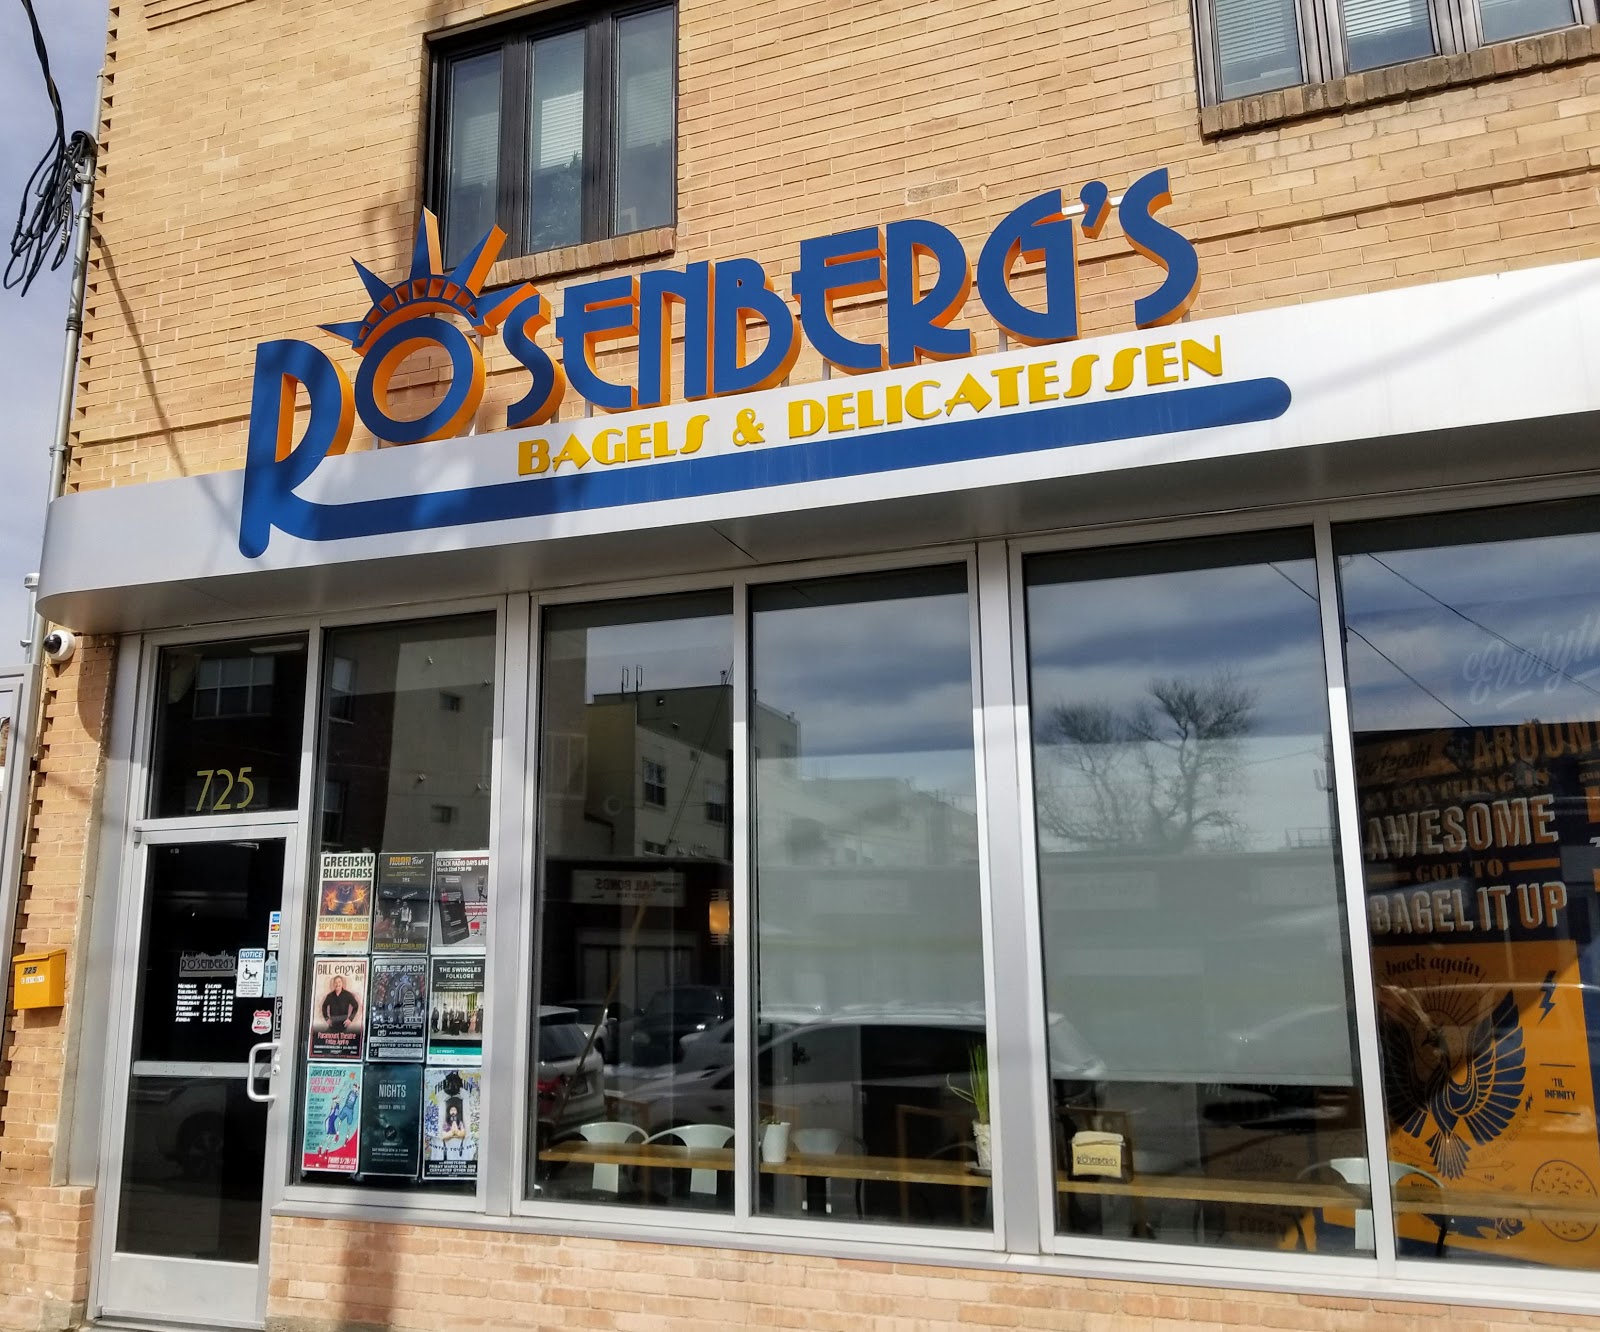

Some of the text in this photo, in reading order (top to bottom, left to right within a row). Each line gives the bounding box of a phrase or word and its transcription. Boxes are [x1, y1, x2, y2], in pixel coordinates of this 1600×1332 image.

[240, 168, 1204, 557] ROSENBERG'S
[517, 334, 1224, 477] BAGELS & DELICATESSEN
[1473, 718, 1600, 771] AROUN
[195, 766, 254, 812] 725
[1364, 793, 1559, 862] AWESOME
[323, 856, 374, 868] GREENSKY
[322, 868, 373, 879] BLUEGRASS
[1415, 857, 1504, 883] GOT TO
[1370, 881, 1567, 936] BAGEL IT UP
[319, 922, 352, 931] SEPTEMBER
[240, 951, 263, 959] NOTICE
[23, 966, 38, 976] 725
[318, 964, 333, 975] BILL
[1385, 952, 1480, 977] back again
[317, 1031, 340, 1039] Paramount
[378, 1084, 407, 1098] NIGHTS
[1544, 1089, 1576, 1102] INFINITY
